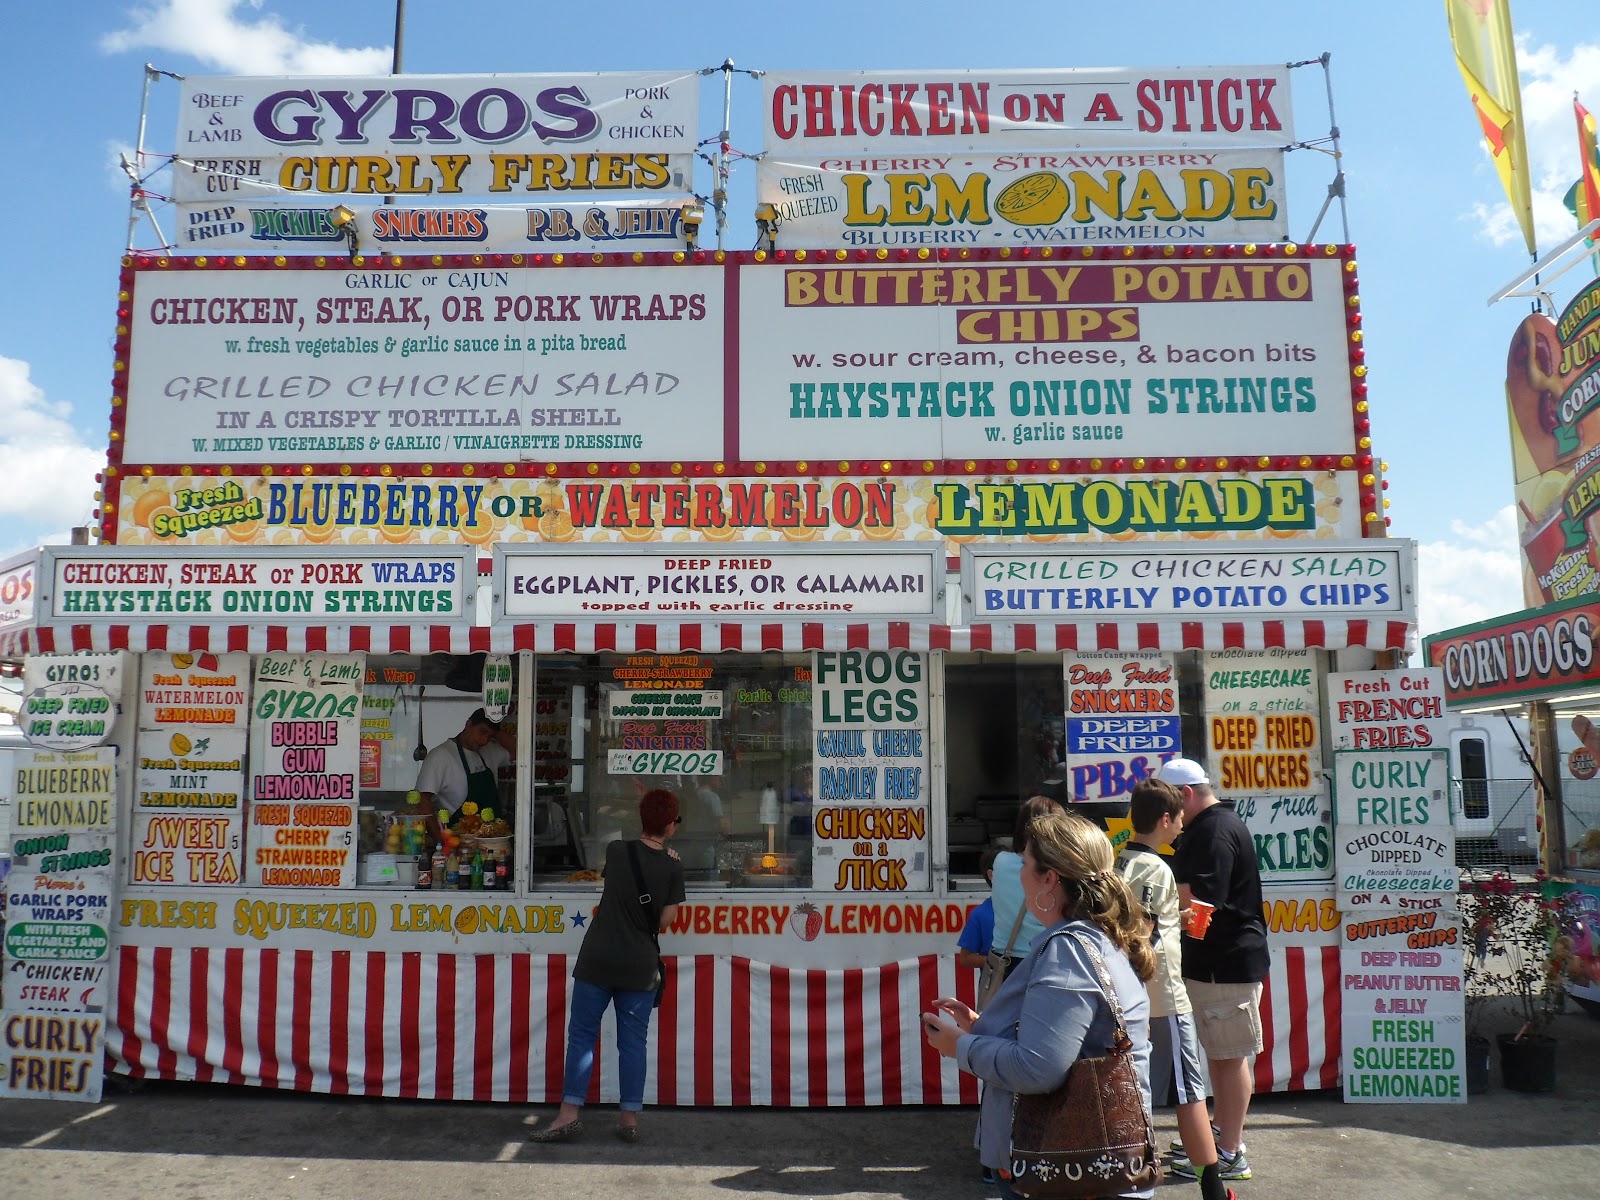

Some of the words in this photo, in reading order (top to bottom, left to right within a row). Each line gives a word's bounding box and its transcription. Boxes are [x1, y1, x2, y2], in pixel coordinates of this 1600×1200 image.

[625, 86, 670, 100] PORK
[253, 85, 602, 146] GYROS
[772, 82, 990, 140] CHICKEN
[1003, 93, 1066, 122] ON
[1084, 93, 1123, 121] A
[1136, 78, 1282, 133] STICK
[188, 129, 242, 143] LAMB
[609, 125, 685, 140] CHICKEN
[278, 155, 471, 194] CURLY
[489, 153, 670, 192] FRIES
[820, 157, 951, 172] CHERRY
[993, 153, 1218, 172] STRAWBERRY
[780, 174, 824, 195] FRESH
[372, 208, 488, 242] SNICKERS
[613, 208, 682, 240] JELLY
[1013, 225, 1205, 241] WATERMELON
[345, 273, 412, 288] GARLIC
[448, 272, 509, 290] CAJUN
[786, 267, 1082, 305] BUTTERFLY
[1112, 265, 1309, 302] POTATO
[150, 298, 305, 332] CHICKEN,
[316, 297, 430, 330] STEAK,
[494, 295, 580, 321] PORK
[590, 294, 706, 321] WRAPS
[959, 308, 1138, 342] CHIPS
[247, 336, 290, 353] fresh
[296, 337, 379, 358] vegetables
[401, 335, 449, 357] garlic
[832, 352, 898, 367] sour
[1015, 346, 1126, 367] cheese,
[1167, 345, 1255, 363] bacon
[284, 410, 380, 428] CRISPY
[388, 408, 521, 428] TORTILLA
[531, 408, 621, 427] SHELL
[212, 437, 263, 452] MIXED
[268, 436, 364, 452] VEGETABLES
[384, 435, 441, 450] GARLIC
[453, 435, 559, 450] VINAIGRETTE
[564, 434, 643, 449] DRESSING
[1013, 421, 1065, 445] garlic
[1072, 424, 1123, 440] sauce
[175, 481, 243, 512] Fresh
[267, 483, 484, 528] BLUEBERRY
[491, 495, 545, 518] OR
[565, 483, 896, 528] WATERMELON
[934, 478, 1316, 535] LEMONADE
[153, 497, 263, 537] Squeezed
[664, 559, 711, 570] DEEP
[719, 558, 772, 570] FRIED
[63, 563, 172, 589] CHICKEN,
[181, 564, 256, 584] STEAK
[301, 563, 363, 584] PORK
[371, 562, 455, 583] WRAPS
[514, 576, 640, 596] EGGPLANT,
[648, 575, 744, 596] PICKLES,
[797, 574, 924, 593] CALAMARI
[1555, 562, 1589, 600] Fresh
[581, 601, 650, 611] topped
[657, 601, 701, 611] with
[709, 601, 768, 612] garlic
[773, 601, 853, 612] dressing
[984, 587, 1160, 611] BUTTERFLY
[1172, 585, 1287, 608] POTATO
[1300, 583, 1390, 606] CHIPS
[627, 656, 654, 666] FRESH
[659, 655, 699, 667] SQUEEZED
[1445, 634, 1508, 690] CORN
[1512, 616, 1593, 679] DOGS
[46, 665, 100, 681] GYROS
[260, 657, 297, 676] Beef
[320, 660, 361, 679] Lamb
[384, 668, 416, 685] Wrap
[817, 651, 922, 684] FROG
[1069, 663, 1112, 688] Deep
[1122, 662, 1172, 687] Fried
[1209, 668, 1312, 690] CHEESECAKE
[1344, 677, 1391, 694] Fresh
[1400, 676, 1430, 691] Cut
[27, 697, 63, 714] DEEP
[68, 697, 109, 715] FRIED
[145, 690, 244, 705] WATERMELON
[737, 688, 773, 703] Garlic
[822, 689, 919, 723] LEGS
[1070, 688, 1175, 714] SNICKERS
[1266, 698, 1304, 711] stick
[1337, 696, 1443, 723] FRENCH
[28, 720, 52, 736] ICE
[57, 720, 105, 737] CREAM
[271, 720, 338, 747] BUBBLE
[623, 735, 706, 750] SNICKERS
[140, 757, 177, 770] Fresh
[179, 758, 240, 772] Squeezed
[283, 748, 326, 774] GUM
[632, 752, 718, 774] GYROS
[1221, 753, 1312, 790] SNICKERS
[17, 768, 111, 794] BLUEBERRY
[170, 775, 208, 788] MINT
[819, 766, 878, 800] PARSLEY
[884, 766, 922, 800] FRIES
[1352, 758, 1432, 790] CURLY
[140, 791, 237, 808] LEMONADE
[18, 800, 109, 826] LEMONADE
[254, 804, 290, 826] FRESH
[293, 805, 352, 828] SQUEEZED
[815, 807, 926, 840] CHICKEN
[143, 817, 230, 849] SWEET
[275, 829, 331, 846] CHERRY
[1346, 830, 1447, 858] CHOCOLATE
[15, 834, 70, 856] ONION
[40, 848, 112, 873] STRINGS
[134, 850, 174, 882] ICE
[187, 851, 239, 884] TEA
[255, 849, 349, 867] STRAWBERRY
[1371, 850, 1422, 863] DIPPED
[834, 858, 908, 891] STICK
[1344, 875, 1454, 890] Cheesecake
[1399, 897, 1443, 909] STICK
[56, 925, 91, 935] FRESH
[119, 899, 217, 929] FRESH
[233, 898, 377, 940] SQUEEZED
[1346, 911, 1437, 941] BUTTERFLY
[1407, 927, 1458, 949] CHIPS
[20, 985, 70, 1001] STEAK
[1345, 975, 1402, 990] PEANUT
[1404, 975, 1461, 991] BUTTER
[1388, 998, 1428, 1014] JELLY
[5, 1015, 102, 1054] CURLY
[1353, 1047, 1455, 1070] SQUEEZED
[9, 1055, 93, 1094] FRIES
[1350, 1075, 1461, 1097] LEMONADE
